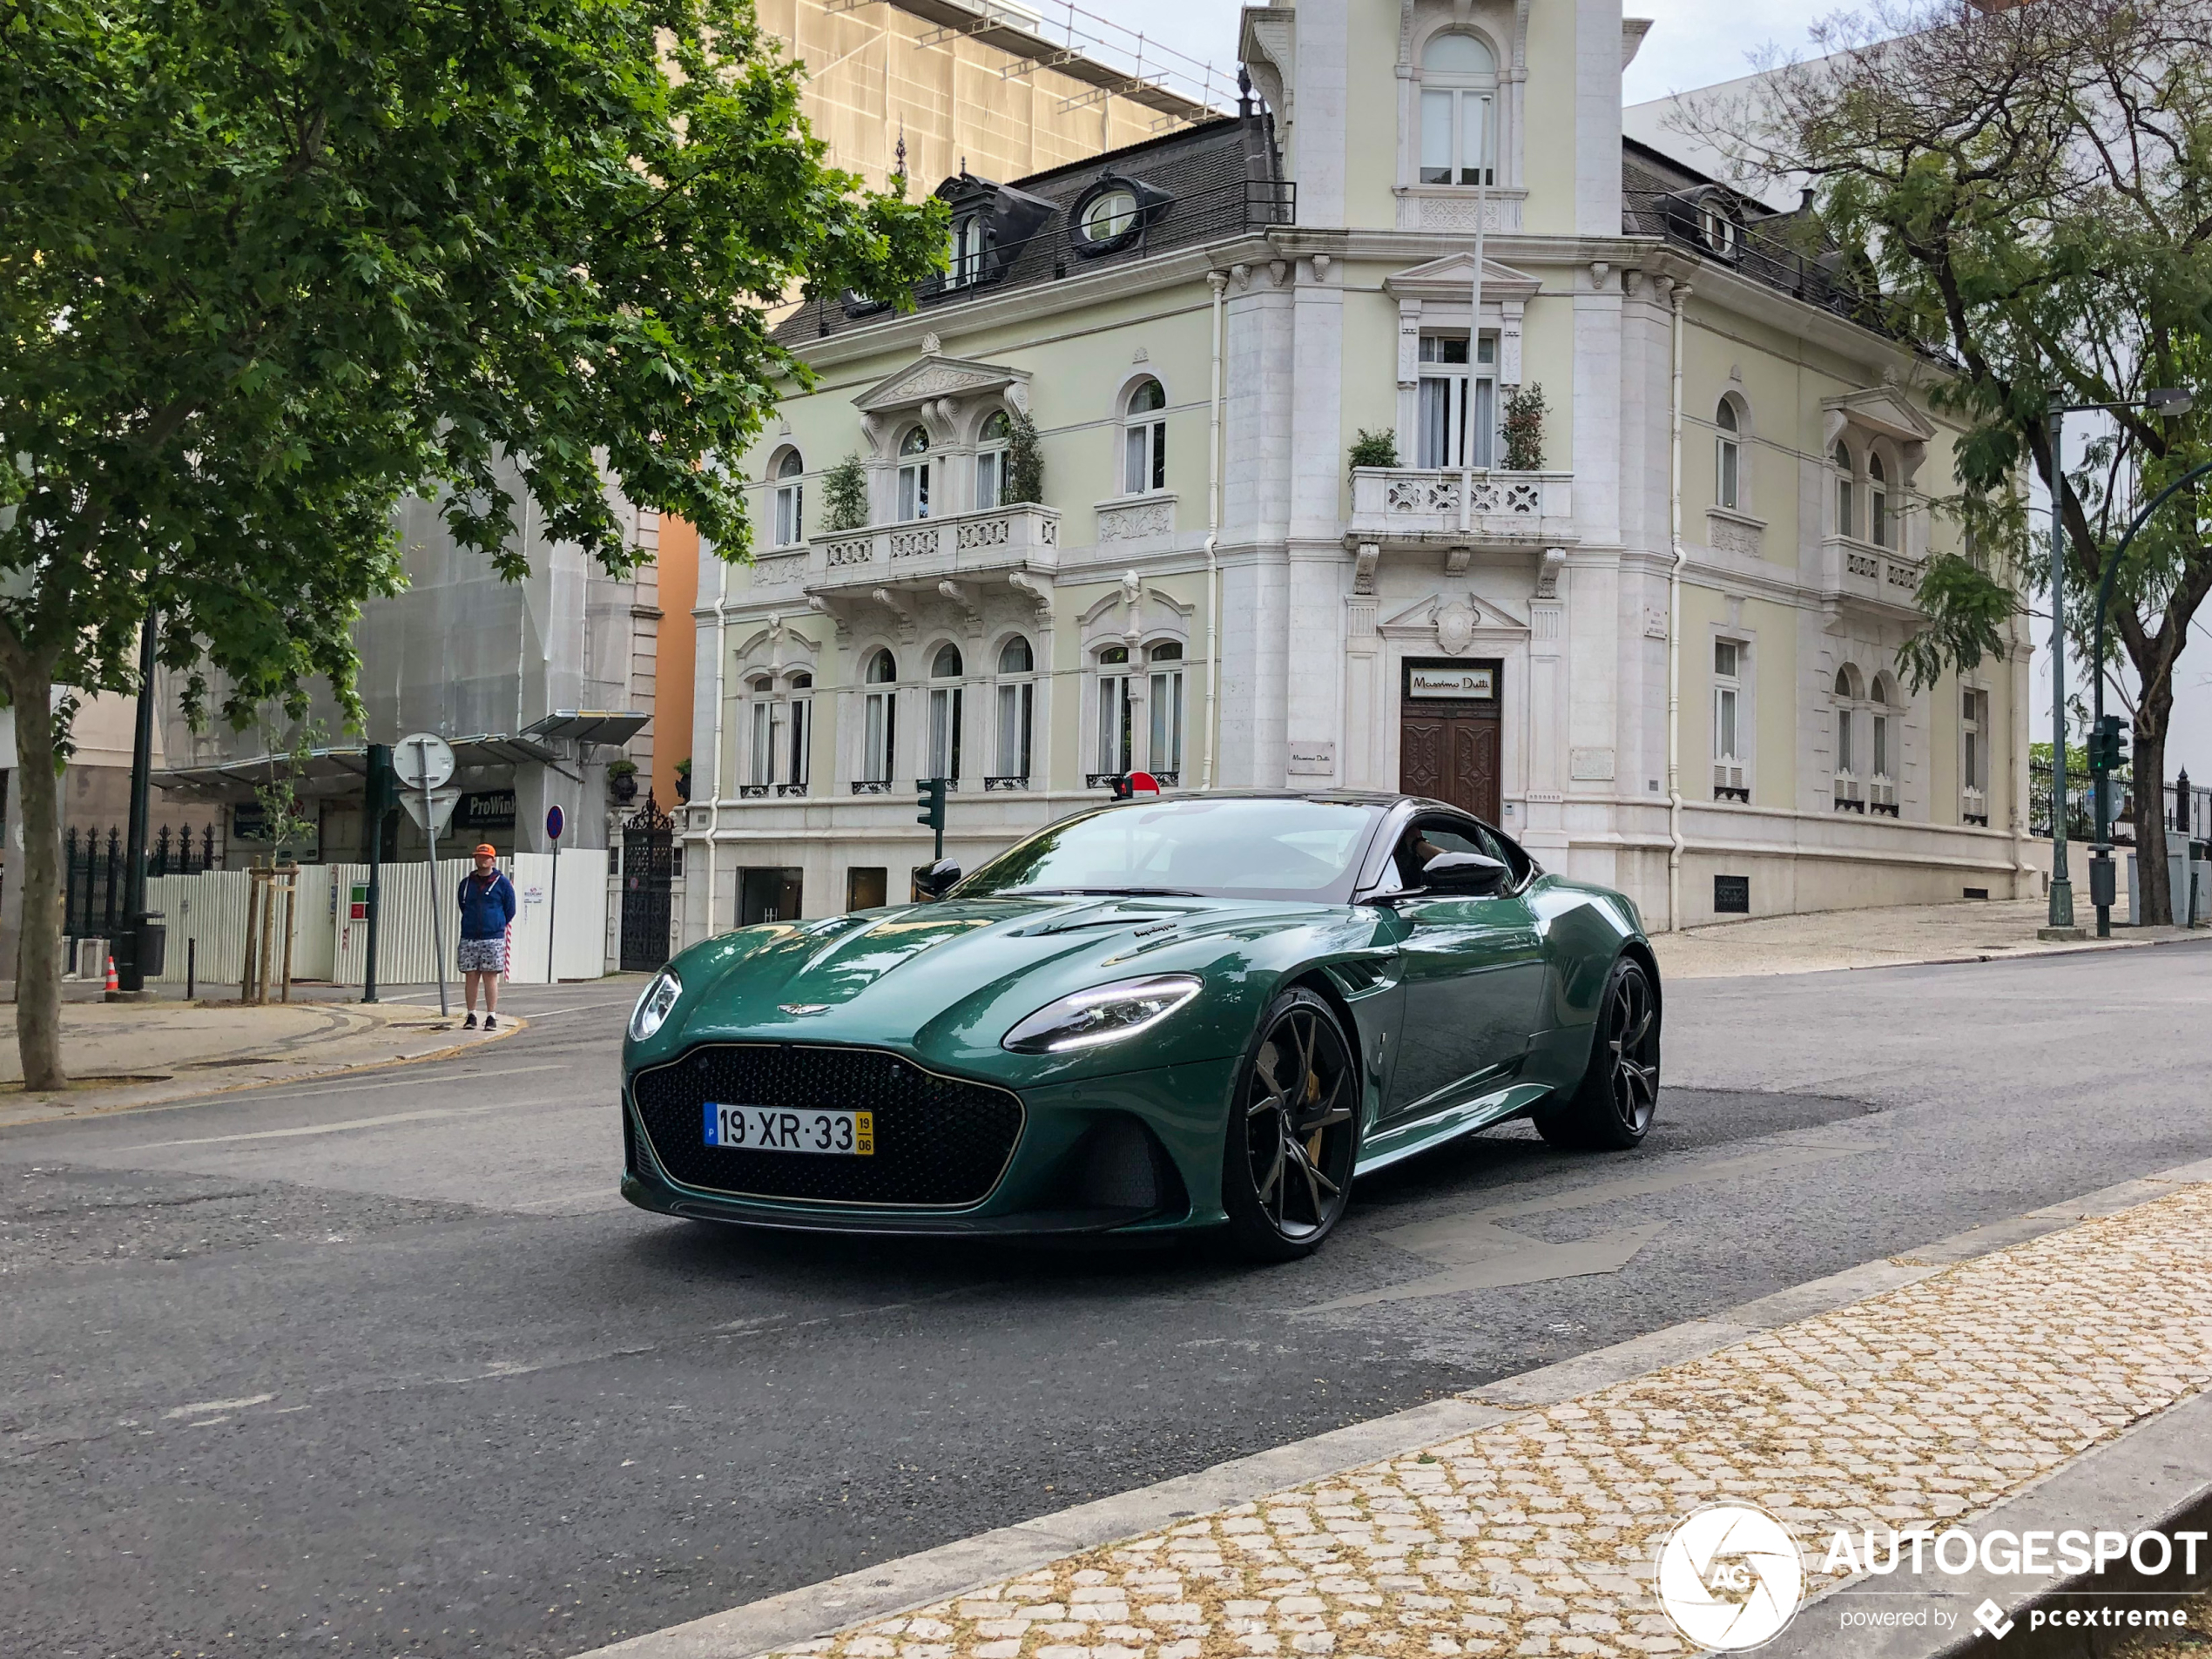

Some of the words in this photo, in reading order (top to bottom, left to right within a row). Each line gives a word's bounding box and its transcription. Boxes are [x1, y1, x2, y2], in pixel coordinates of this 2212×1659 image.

[1413, 677, 1460, 688] Massimo
[1462, 678, 1490, 689] Dutti
[859, 1118, 870, 1129] 19
[859, 1140, 872, 1151] 06
